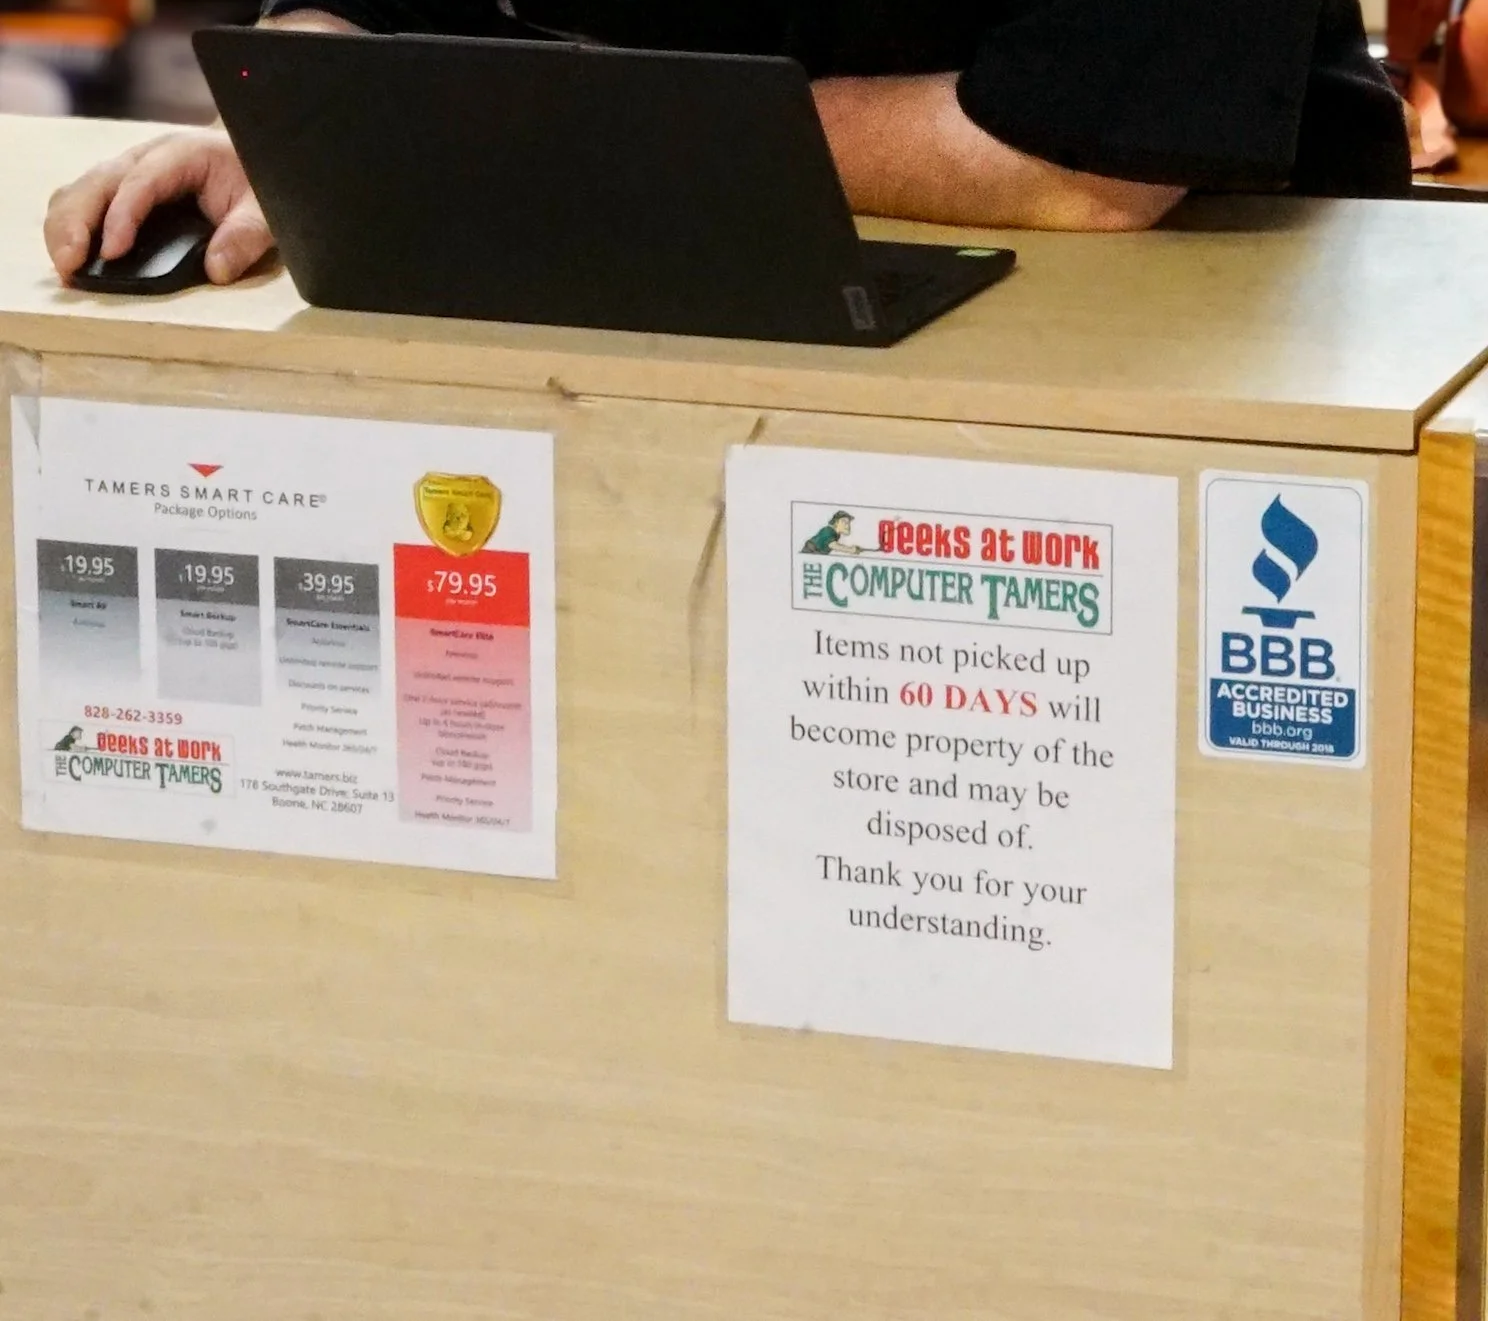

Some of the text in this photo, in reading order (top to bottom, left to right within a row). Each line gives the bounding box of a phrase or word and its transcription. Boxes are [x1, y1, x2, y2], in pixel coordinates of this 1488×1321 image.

[85, 478, 170, 497] TAMERS
[180, 485, 254, 503] SMART
[154, 503, 257, 520] Package Options
[981, 527, 1015, 563] at
[427, 571, 497, 597] $79.95
[803, 561, 1100, 628] THE COMPUTER TAMERS
[815, 630, 1090, 679] Items not picked up
[1221, 631, 1335, 680] BBB
[803, 675, 1101, 723] within 60 DAYS will
[1217, 683, 1348, 708] ACCREDITED
[84, 705, 183, 725] 828-262-3359
[1233, 701, 1333, 724] BUSINESS
[790, 715, 1114, 768] become property of the
[1252, 721, 1313, 740] bbb.org
[154, 737, 174, 758] at
[1229, 736, 1258, 747] VALID
[1261, 739, 1310, 752] THROUGH
[55, 755, 222, 793] THE COMPUTER TAMERS
[275, 769, 358, 784] www.tamers.biz
[241, 778, 258, 790] 178
[262, 781, 315, 795] Southgate
[352, 789, 379, 801] Suite
[382, 791, 395, 802] 13
[833, 768, 1070, 811] store and may be
[312, 799, 329, 810] NC
[331, 801, 363, 814] 28607
[867, 811, 1033, 850] disposed of.
[816, 854, 1087, 906] Thank you for your
[849, 905, 1051, 951] understanding.
